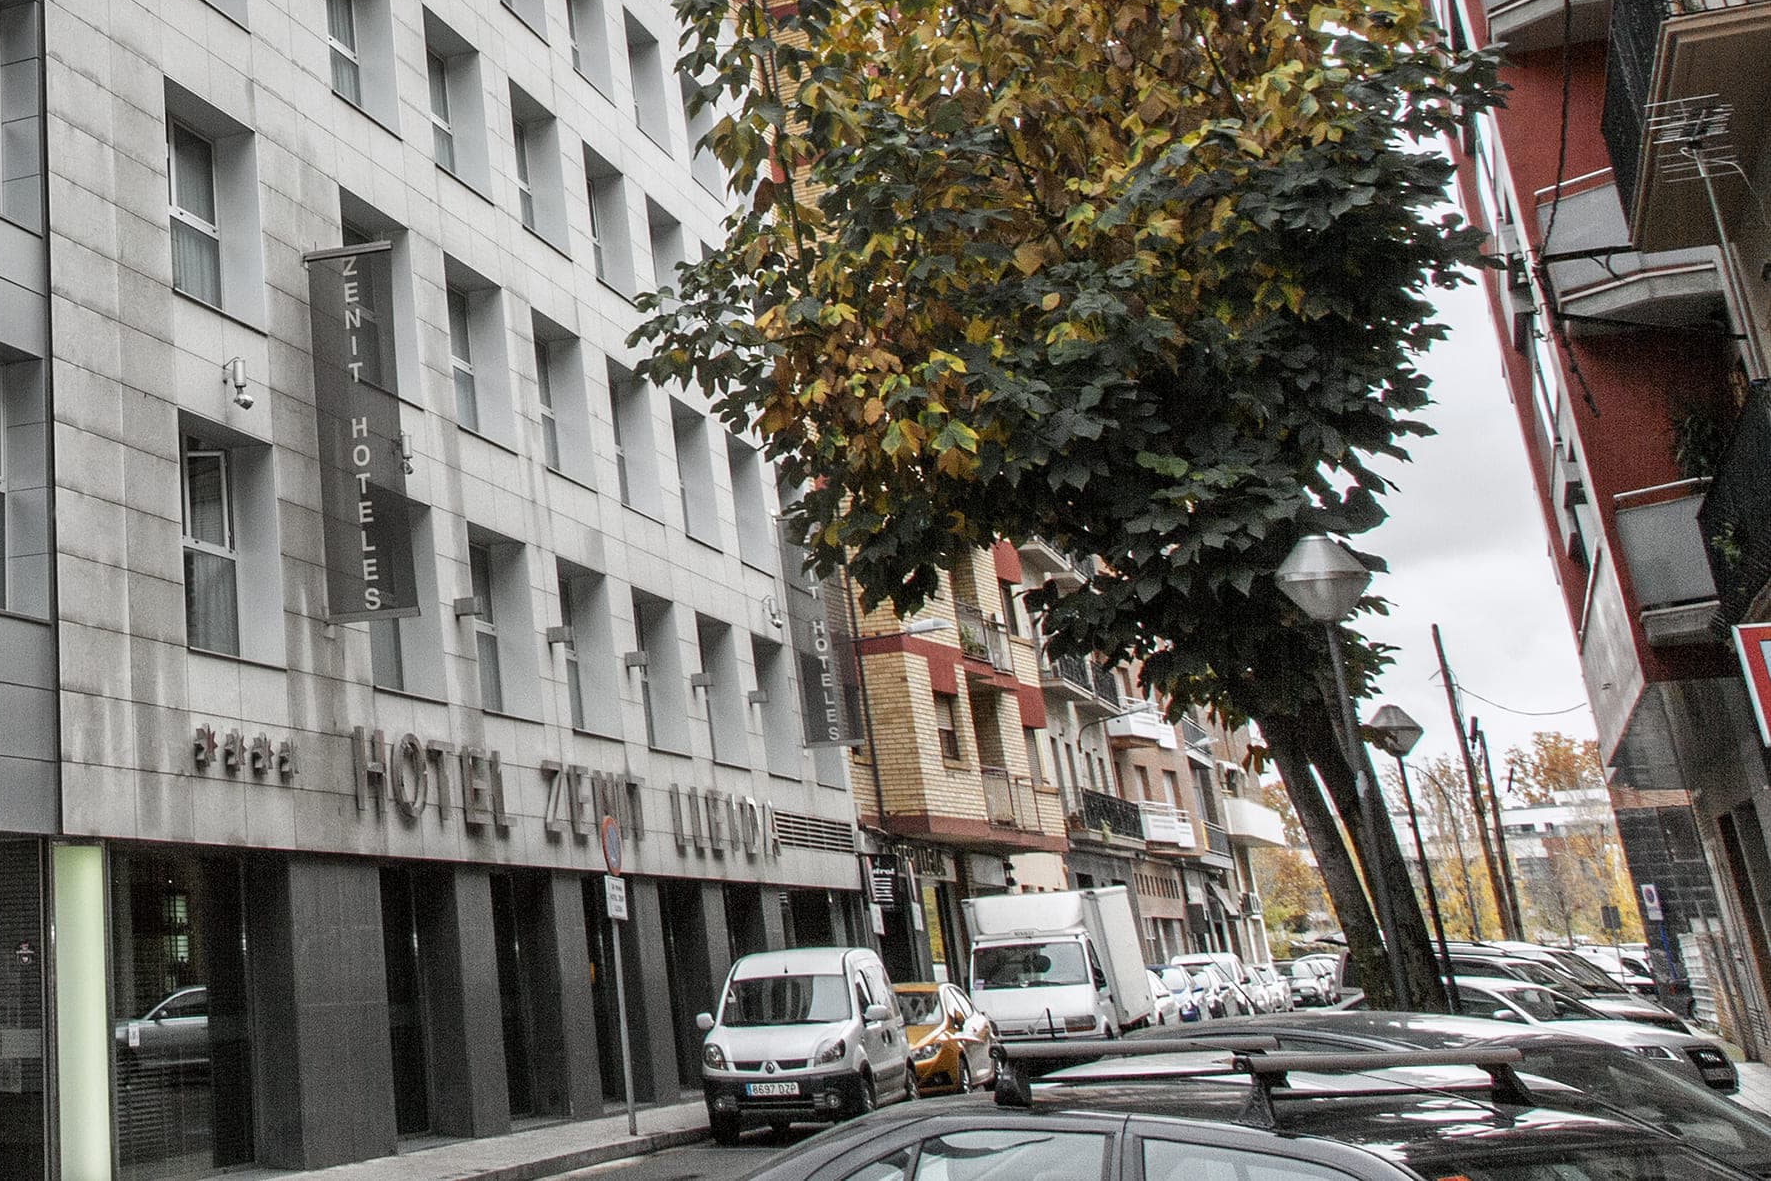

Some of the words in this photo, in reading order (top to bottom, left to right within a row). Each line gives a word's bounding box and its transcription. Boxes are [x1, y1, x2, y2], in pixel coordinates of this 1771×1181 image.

[342, 256, 363, 382] ZENIT
[352, 417, 381, 610] HOTELES
[812, 620, 840, 741] HOTELES
[353, 725, 517, 827] HOTEL
[541, 760, 646, 841] ZENIT
[670, 783, 781, 857] LLEIDA
